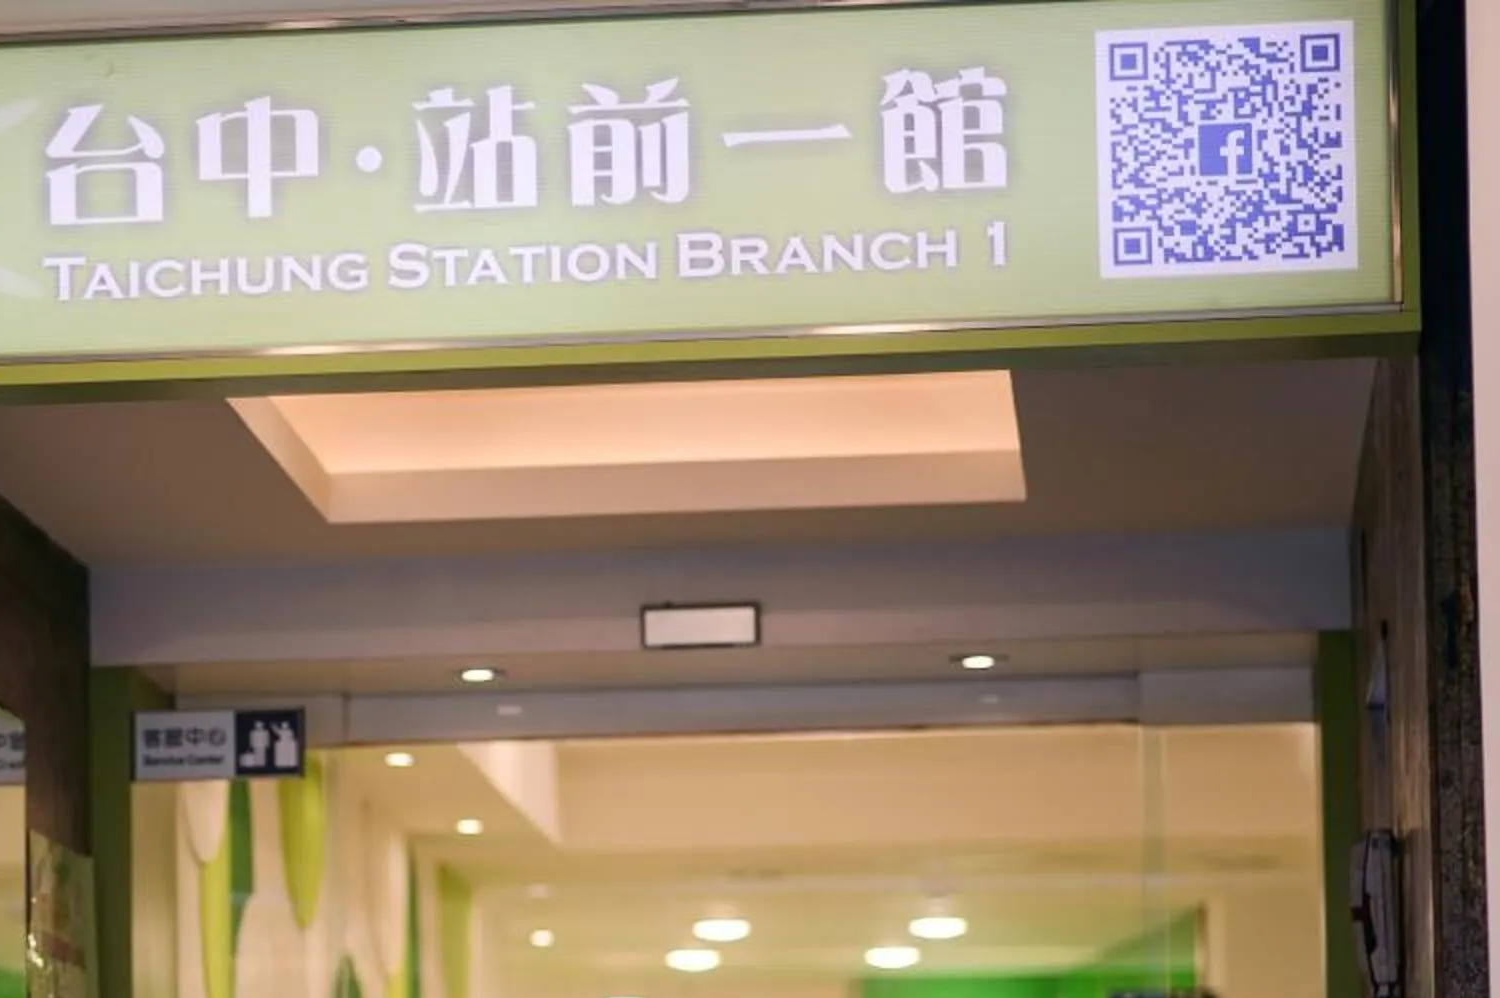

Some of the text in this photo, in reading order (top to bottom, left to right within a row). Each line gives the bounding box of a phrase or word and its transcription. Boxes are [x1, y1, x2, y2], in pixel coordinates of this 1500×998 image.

[43, 220, 1007, 301] TAICHUNG STATION BRANCH 1
